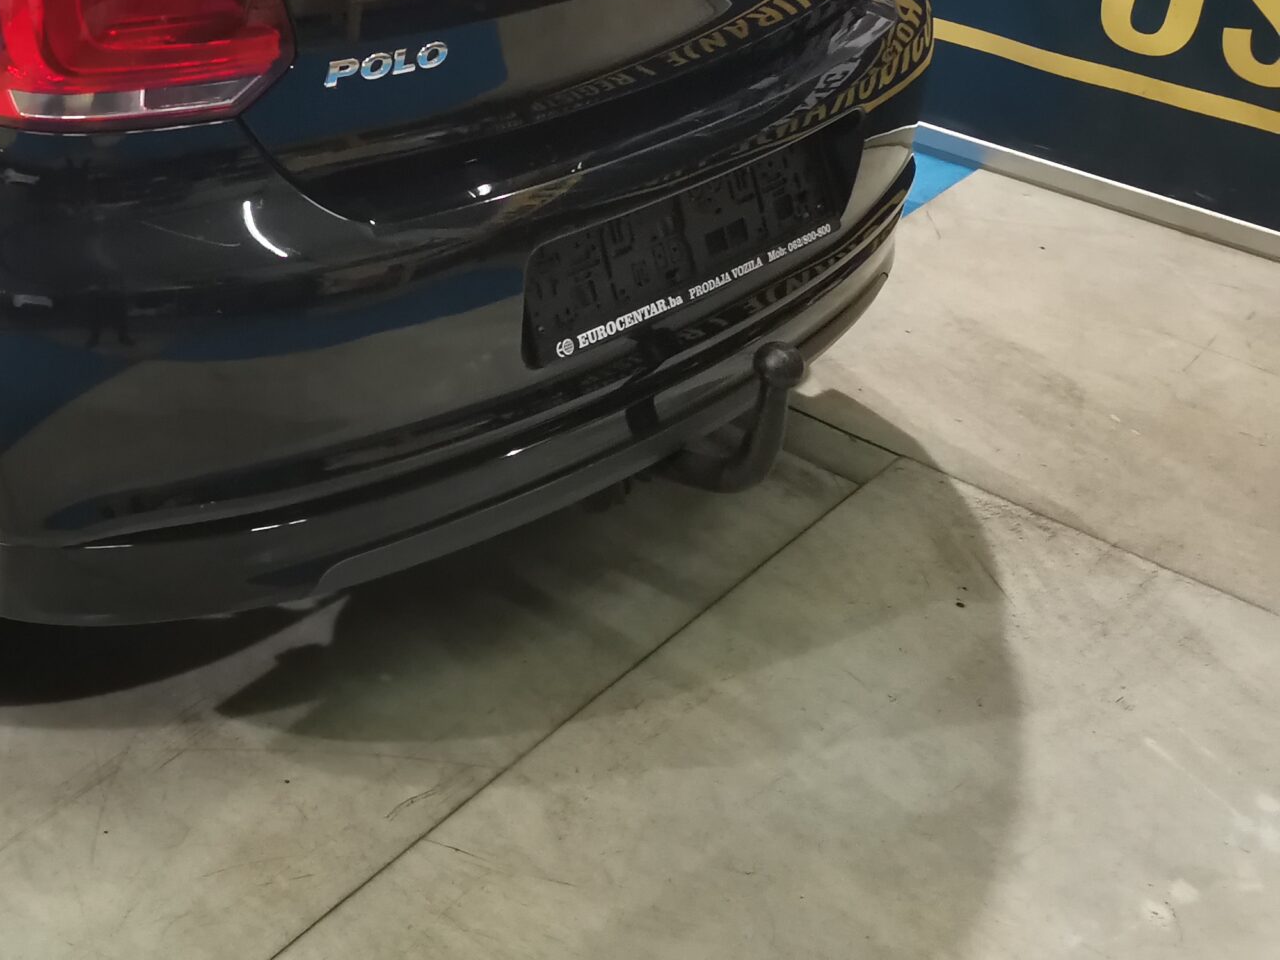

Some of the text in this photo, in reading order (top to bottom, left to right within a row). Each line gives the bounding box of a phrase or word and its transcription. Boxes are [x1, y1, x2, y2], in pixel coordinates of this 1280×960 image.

[323, 41, 449, 88] POLO
[576, 295, 684, 349] EUROCENTAR.ba
[688, 271, 732, 300] PRODAJA
[731, 256, 764, 279] VOZILA
[767, 246, 787, 262] Mob:
